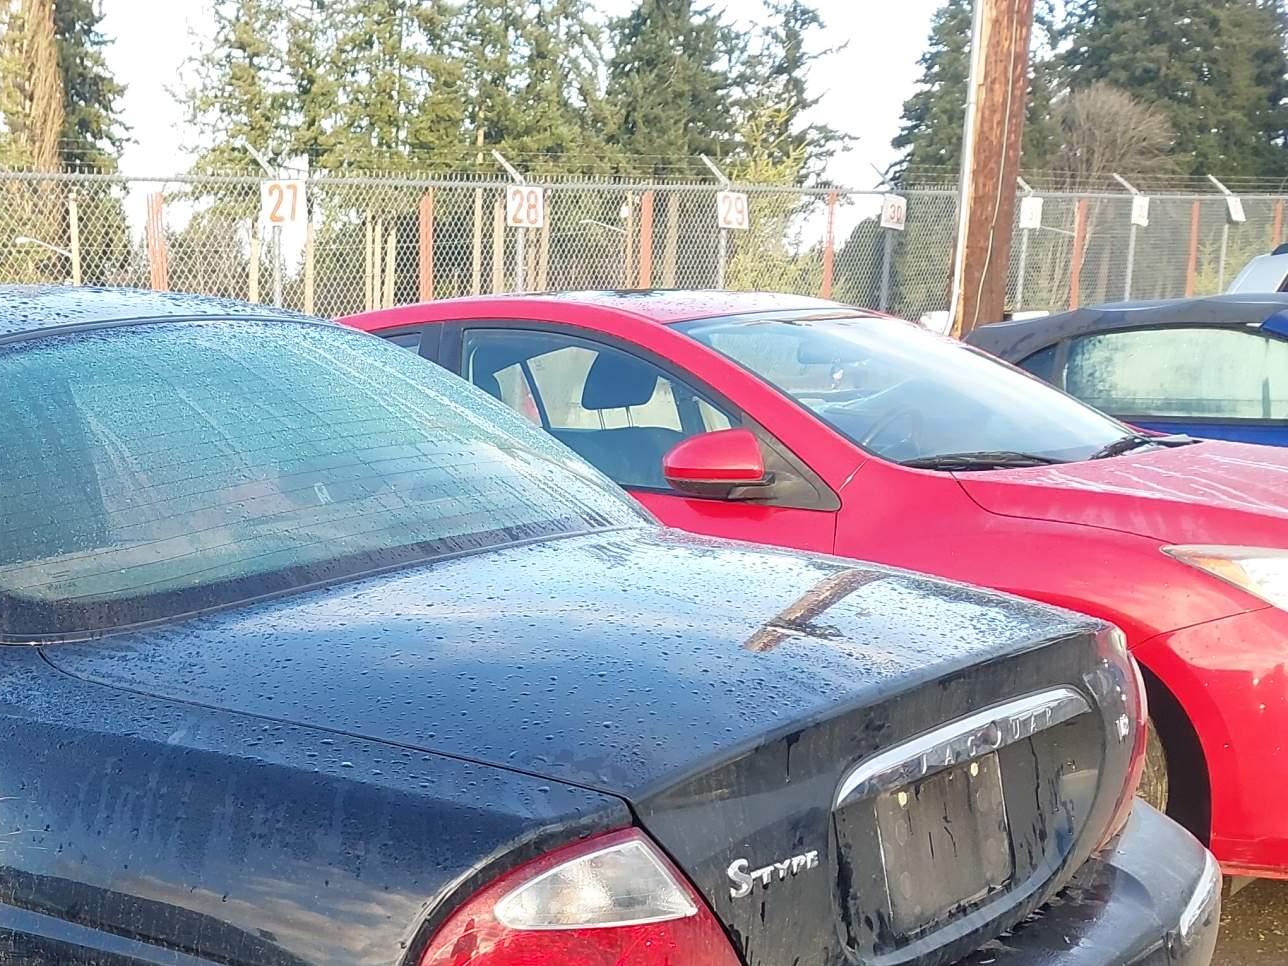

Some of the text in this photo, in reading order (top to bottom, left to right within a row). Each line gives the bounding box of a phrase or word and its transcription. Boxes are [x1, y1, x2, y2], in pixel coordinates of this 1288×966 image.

[268, 183, 297, 222] 27
[511, 189, 539, 225] 28
[722, 194, 745, 226] 29
